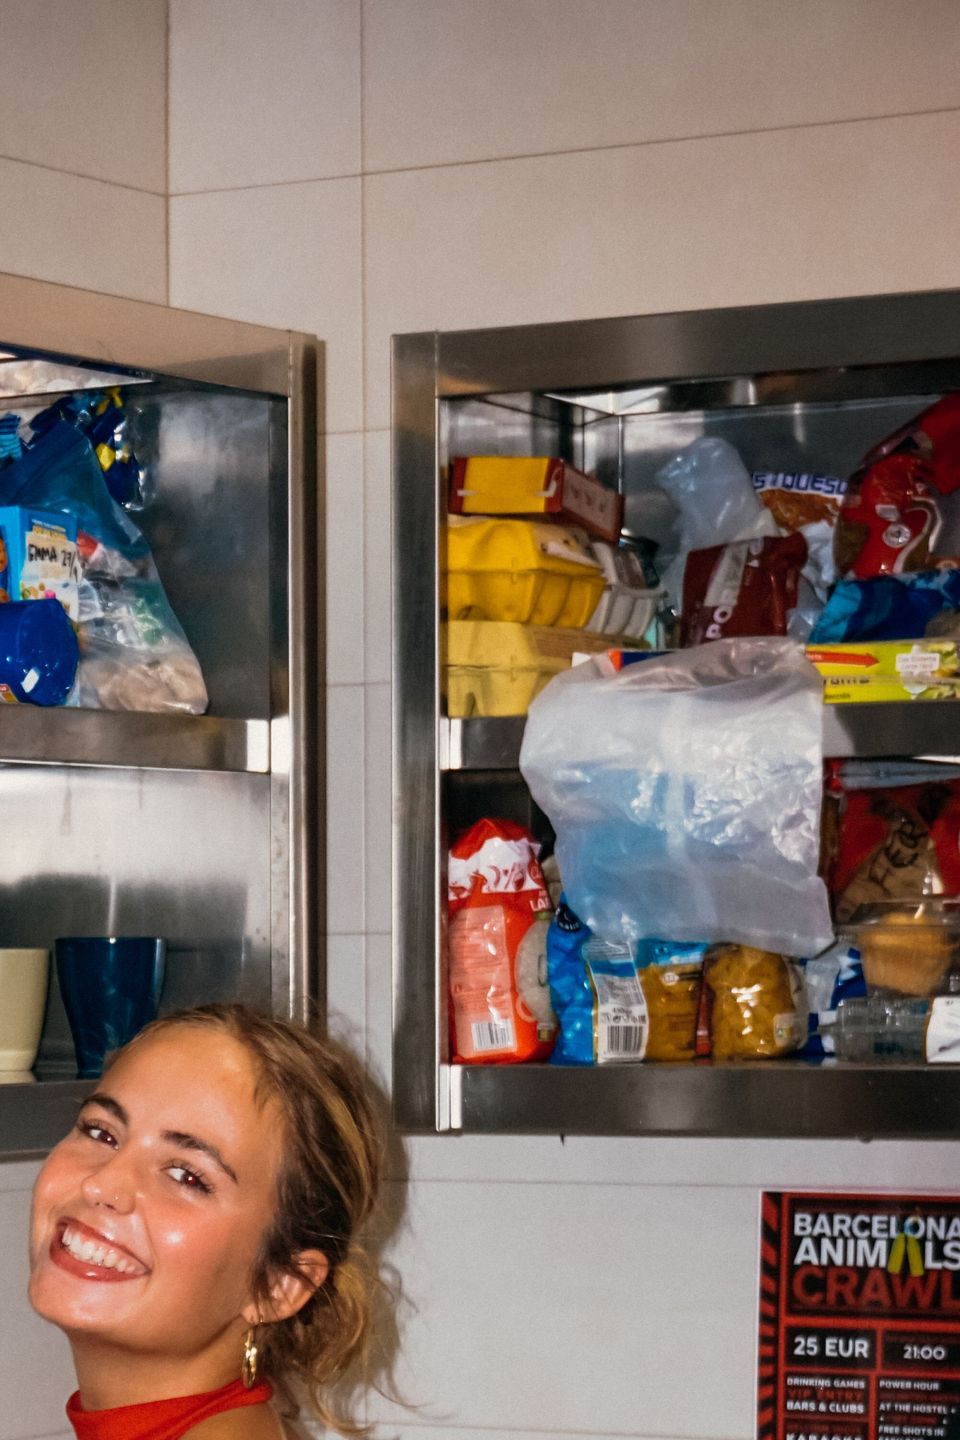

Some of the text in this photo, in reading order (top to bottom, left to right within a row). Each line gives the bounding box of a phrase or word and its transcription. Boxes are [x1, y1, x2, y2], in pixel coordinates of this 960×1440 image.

[794, 1213, 960, 1240] BARCELONA
[792, 1265, 960, 1311] CRAWL
[793, 1335, 869, 1358] 25 EUR
[903, 1344, 946, 1360] 21:00
[786, 1376, 865, 1390] DRINKING GAMES
[879, 1380, 940, 1391] POWER HOUR
[786, 1401, 816, 1412] BARS
[829, 1403, 865, 1414] CLUBS
[879, 1402, 948, 1415] AT THE HOSTEL
[878, 1425, 901, 1435] FREE
[902, 1426, 933, 1437] SHOTS
